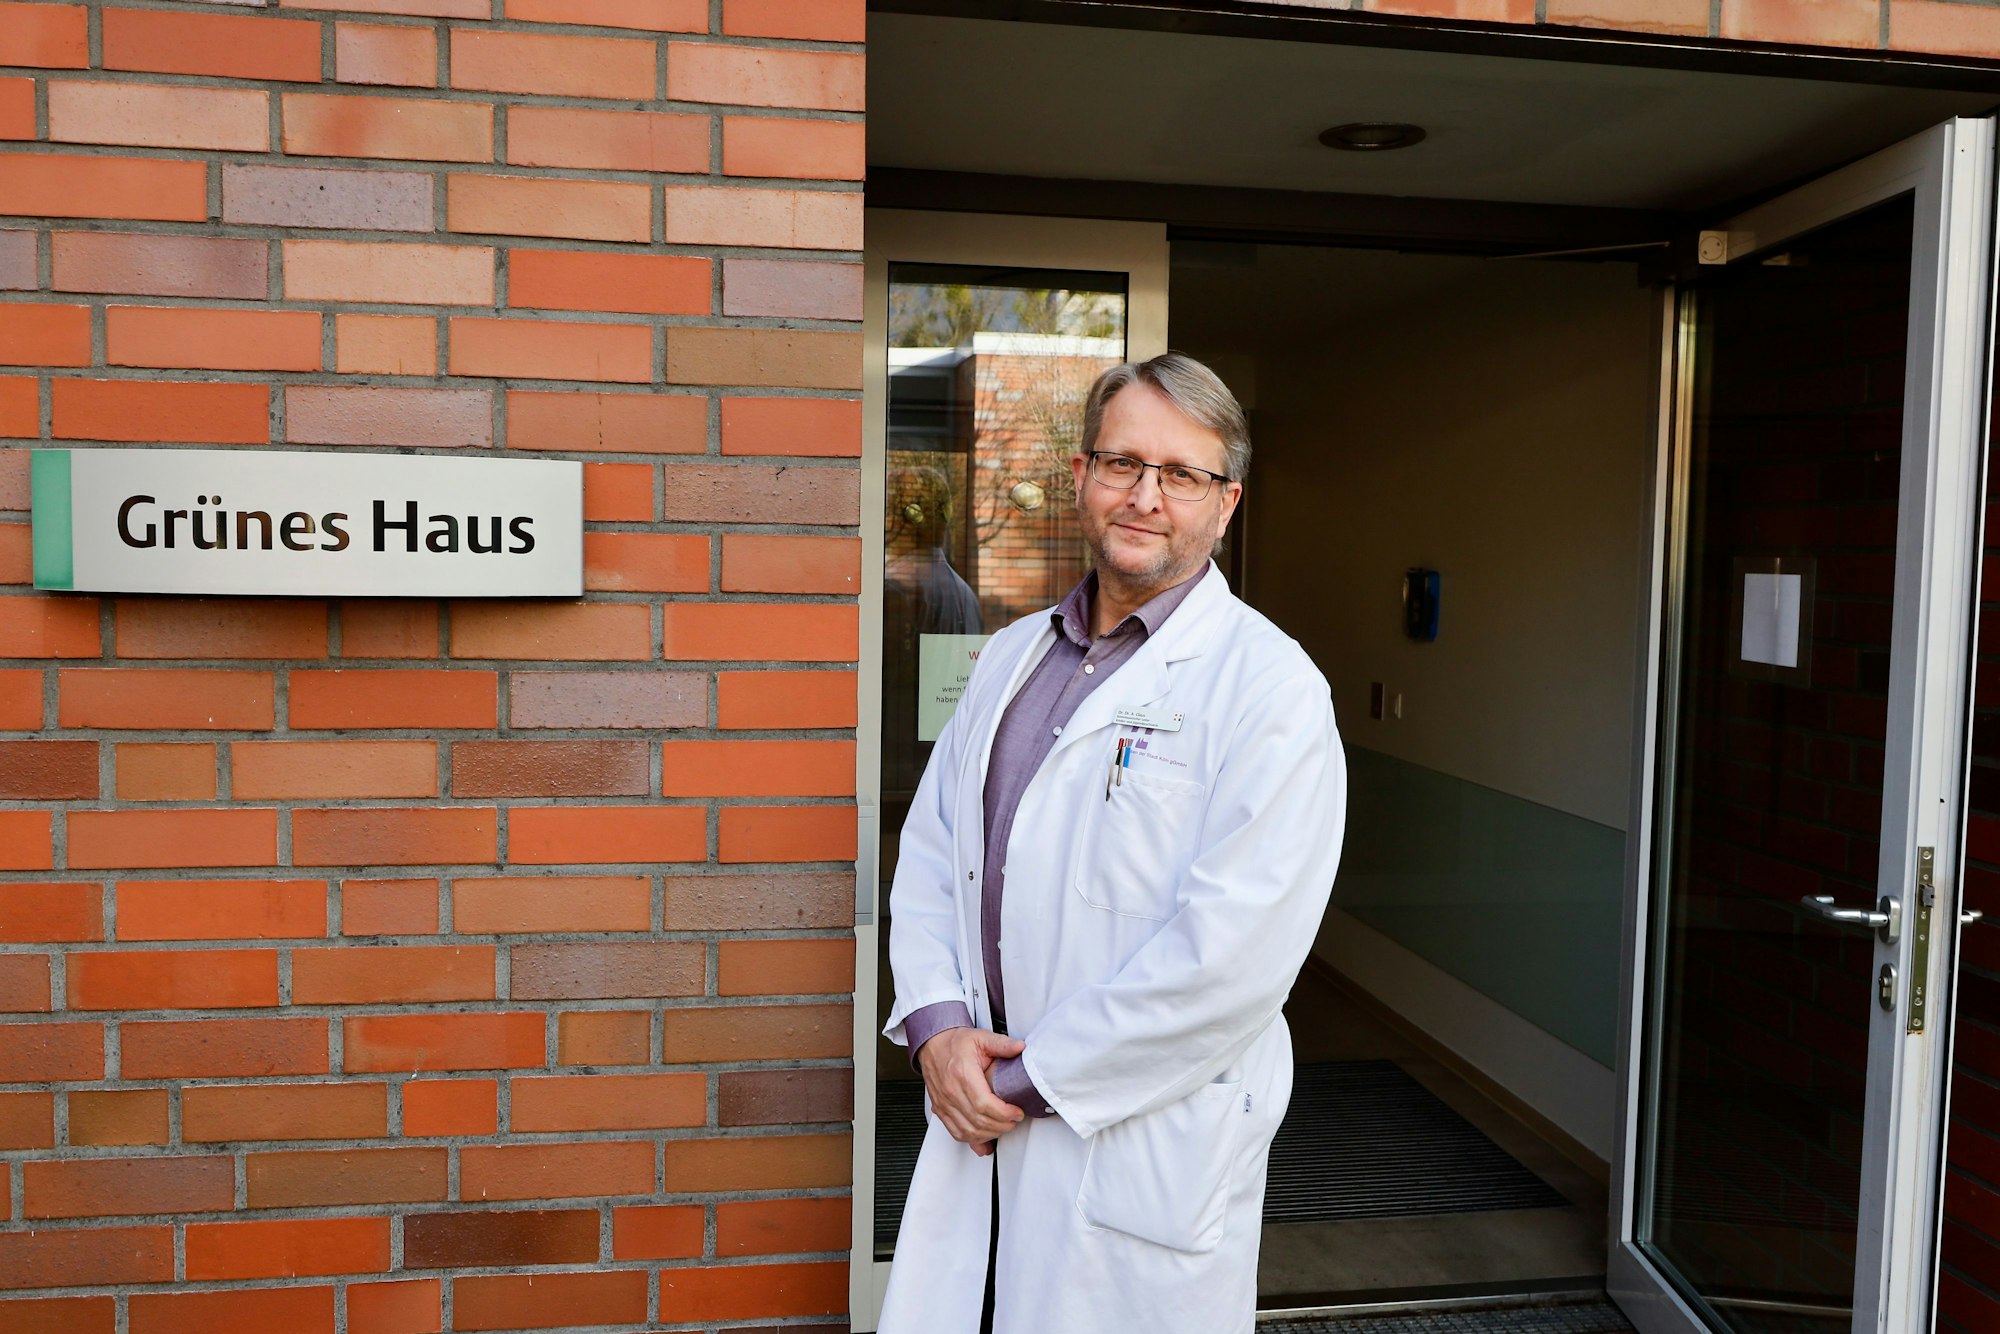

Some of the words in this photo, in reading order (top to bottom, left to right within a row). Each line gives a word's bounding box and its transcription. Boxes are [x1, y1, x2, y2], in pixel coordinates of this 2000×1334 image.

[117, 494, 350, 552] Grünes
[372, 499, 536, 554] Haus
[935, 695, 959, 703] haben
